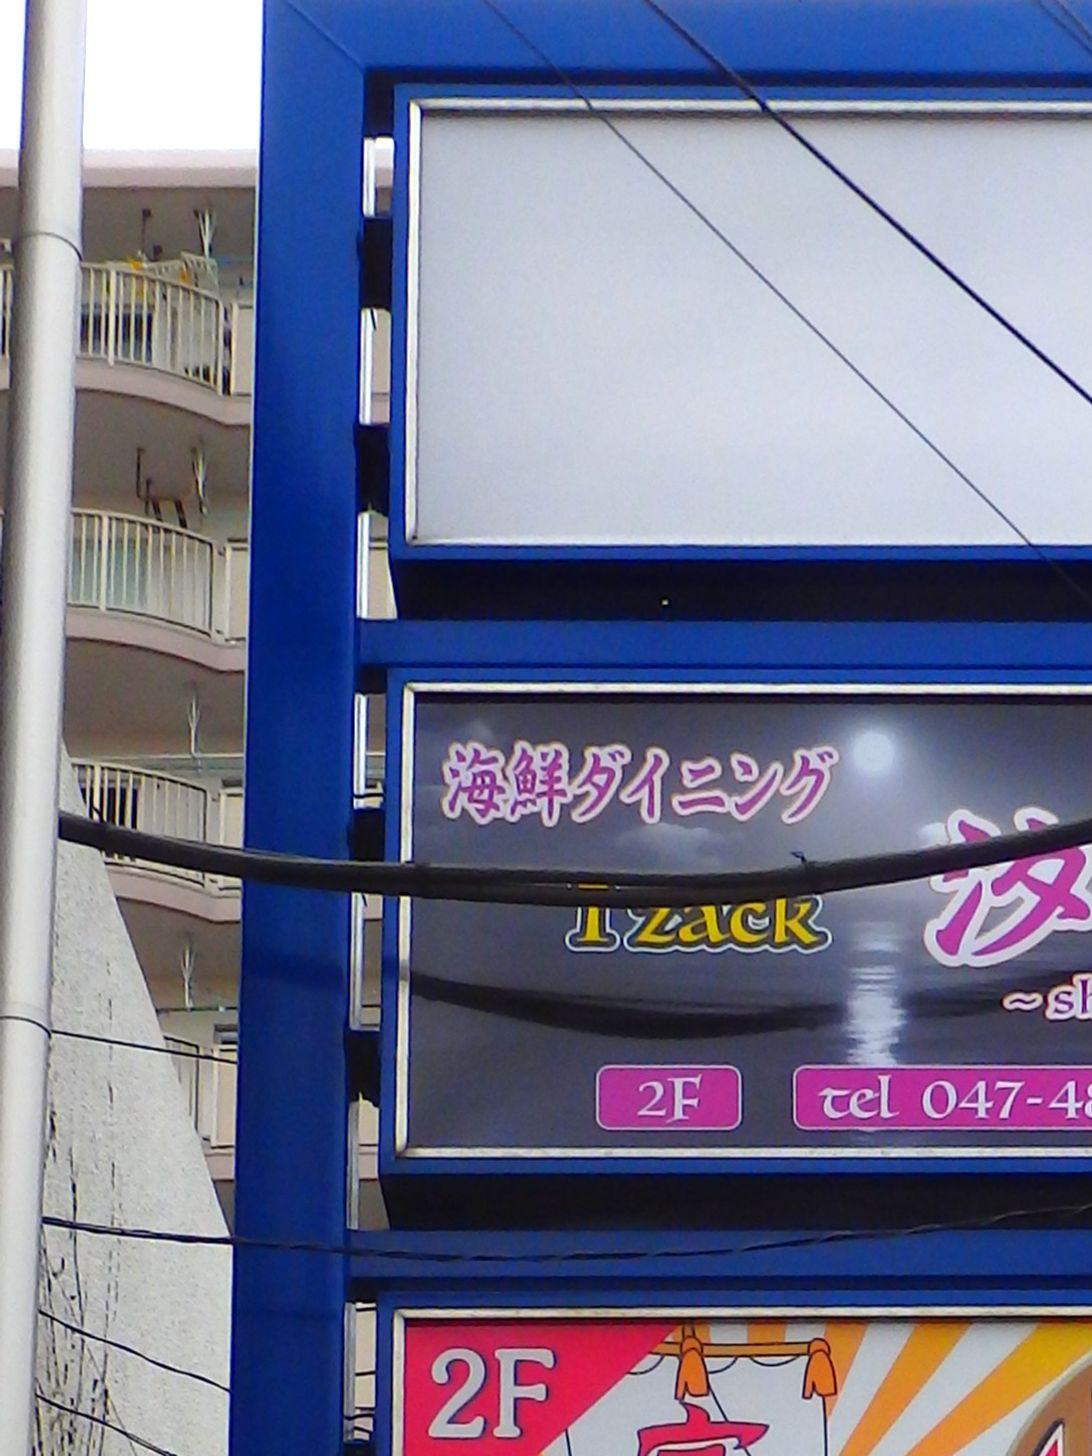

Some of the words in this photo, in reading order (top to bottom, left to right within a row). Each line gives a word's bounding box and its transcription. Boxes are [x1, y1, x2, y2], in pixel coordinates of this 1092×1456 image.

[443, 741, 838, 827] 海鮮ダイニング
[637, 1074, 702, 1124] 2F
[818, 1074, 898, 1121] tel
[427, 1347, 558, 1440] 2F
